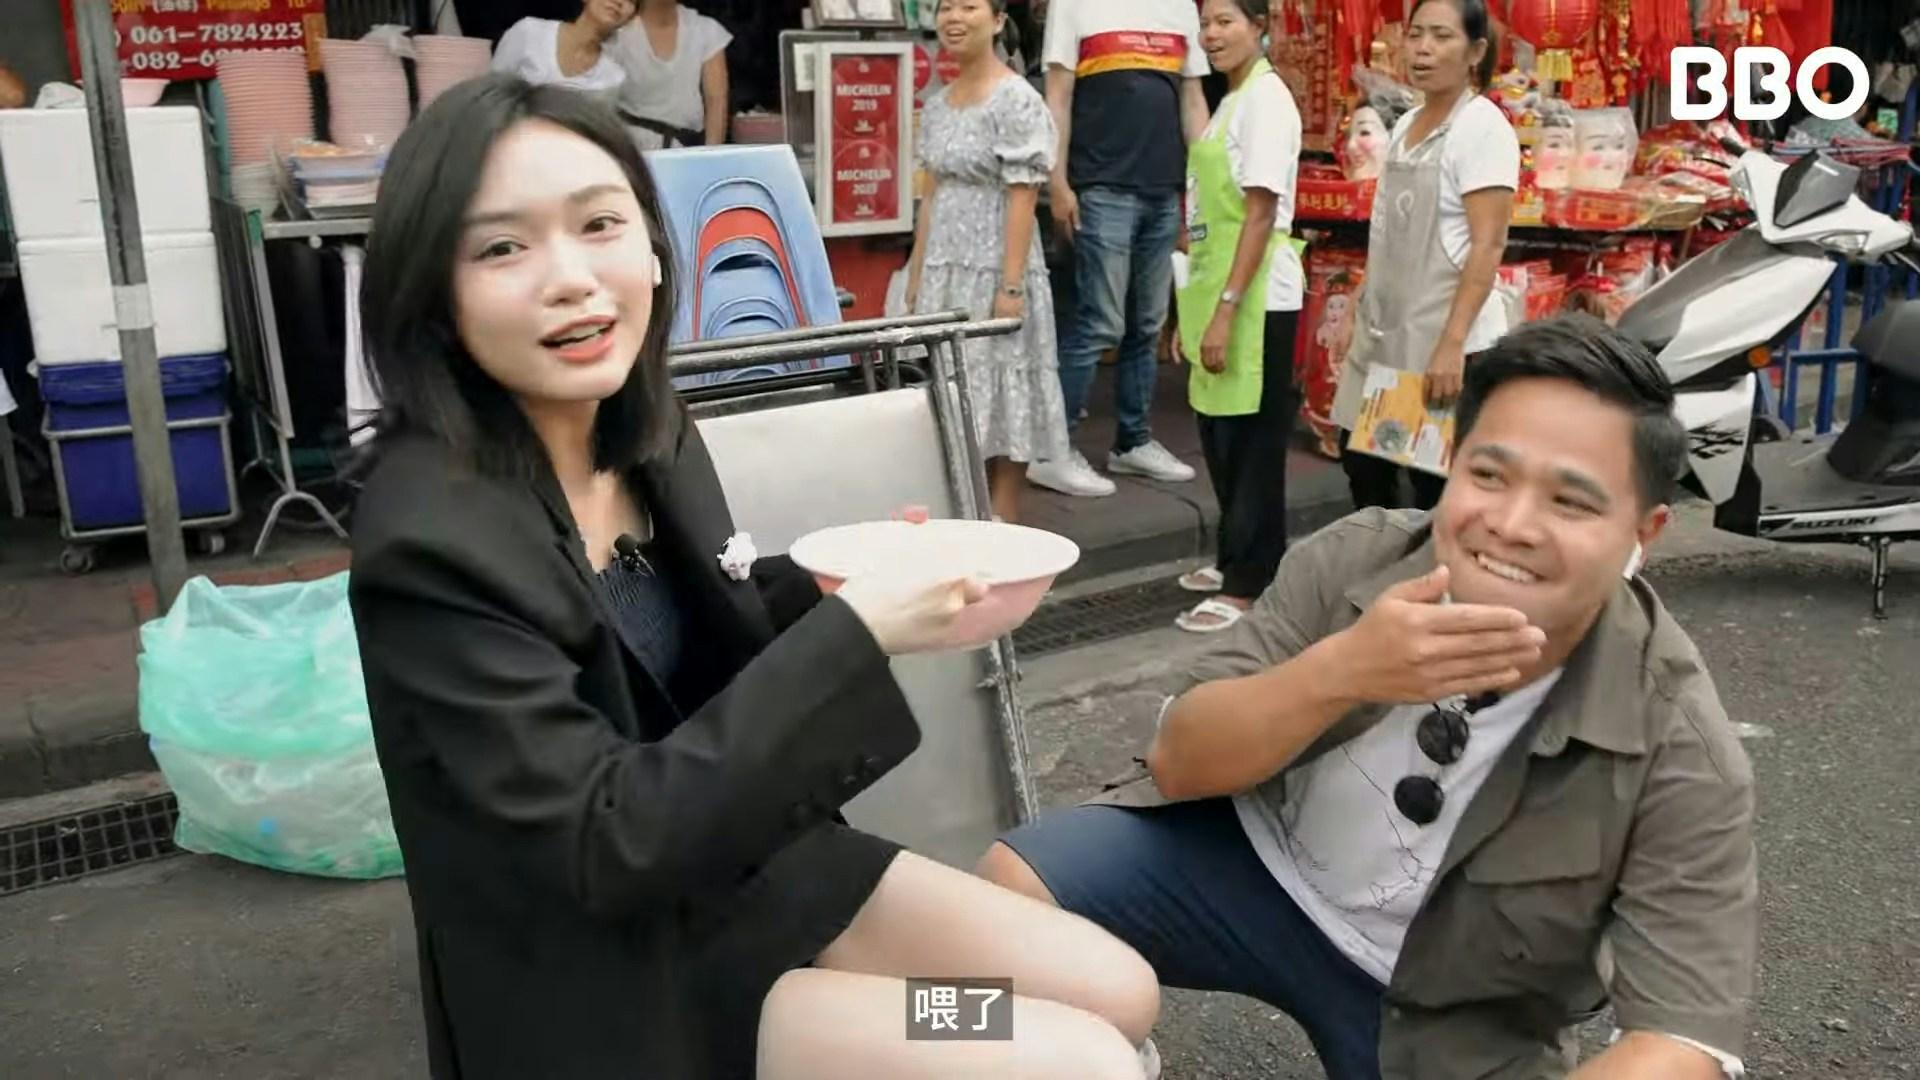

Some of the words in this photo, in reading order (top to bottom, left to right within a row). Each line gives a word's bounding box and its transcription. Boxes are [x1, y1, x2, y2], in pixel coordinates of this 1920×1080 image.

[131, 22, 303, 44] 061-7824223
[836, 84, 892, 97] MICHELIN
[837, 169, 892, 181] MICHELIN
[1790, 516, 1877, 529] SUZUKI
